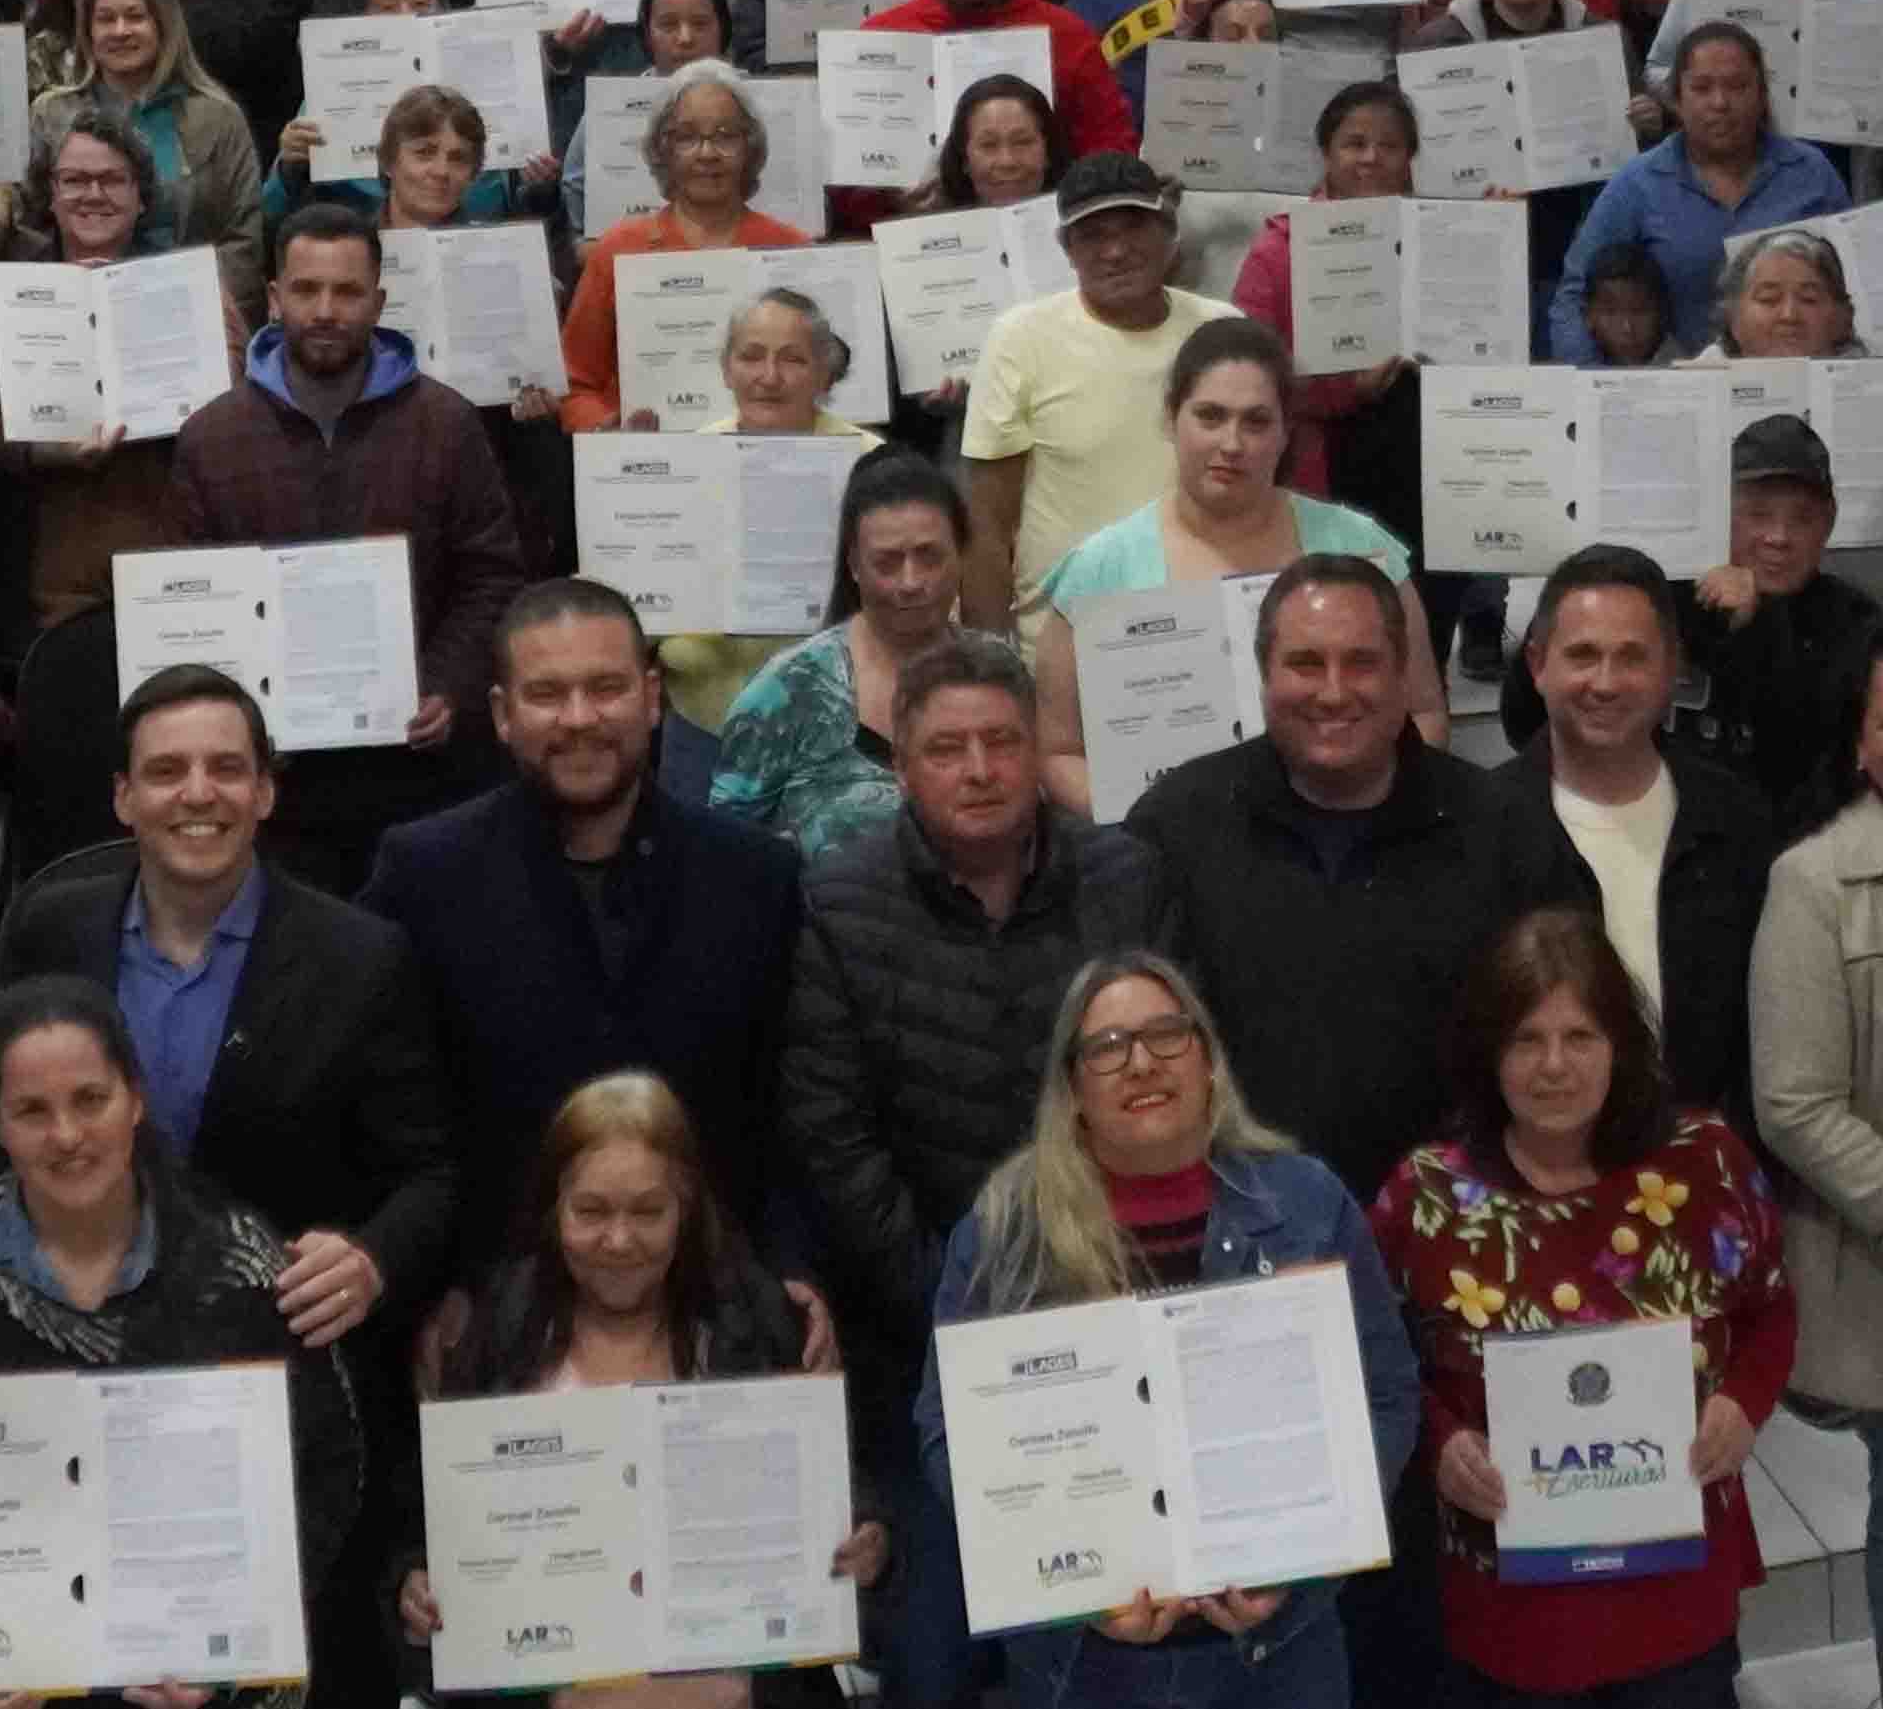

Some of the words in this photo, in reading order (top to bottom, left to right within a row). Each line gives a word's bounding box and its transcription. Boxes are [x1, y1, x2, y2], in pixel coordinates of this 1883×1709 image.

[1027, 1350, 1078, 1375] LAGES
[509, 1433, 563, 1454] LAGES
[1530, 1442, 1617, 1473] LAR
[1039, 1551, 1079, 1575] LAR
[506, 1626, 549, 1646] LAR
